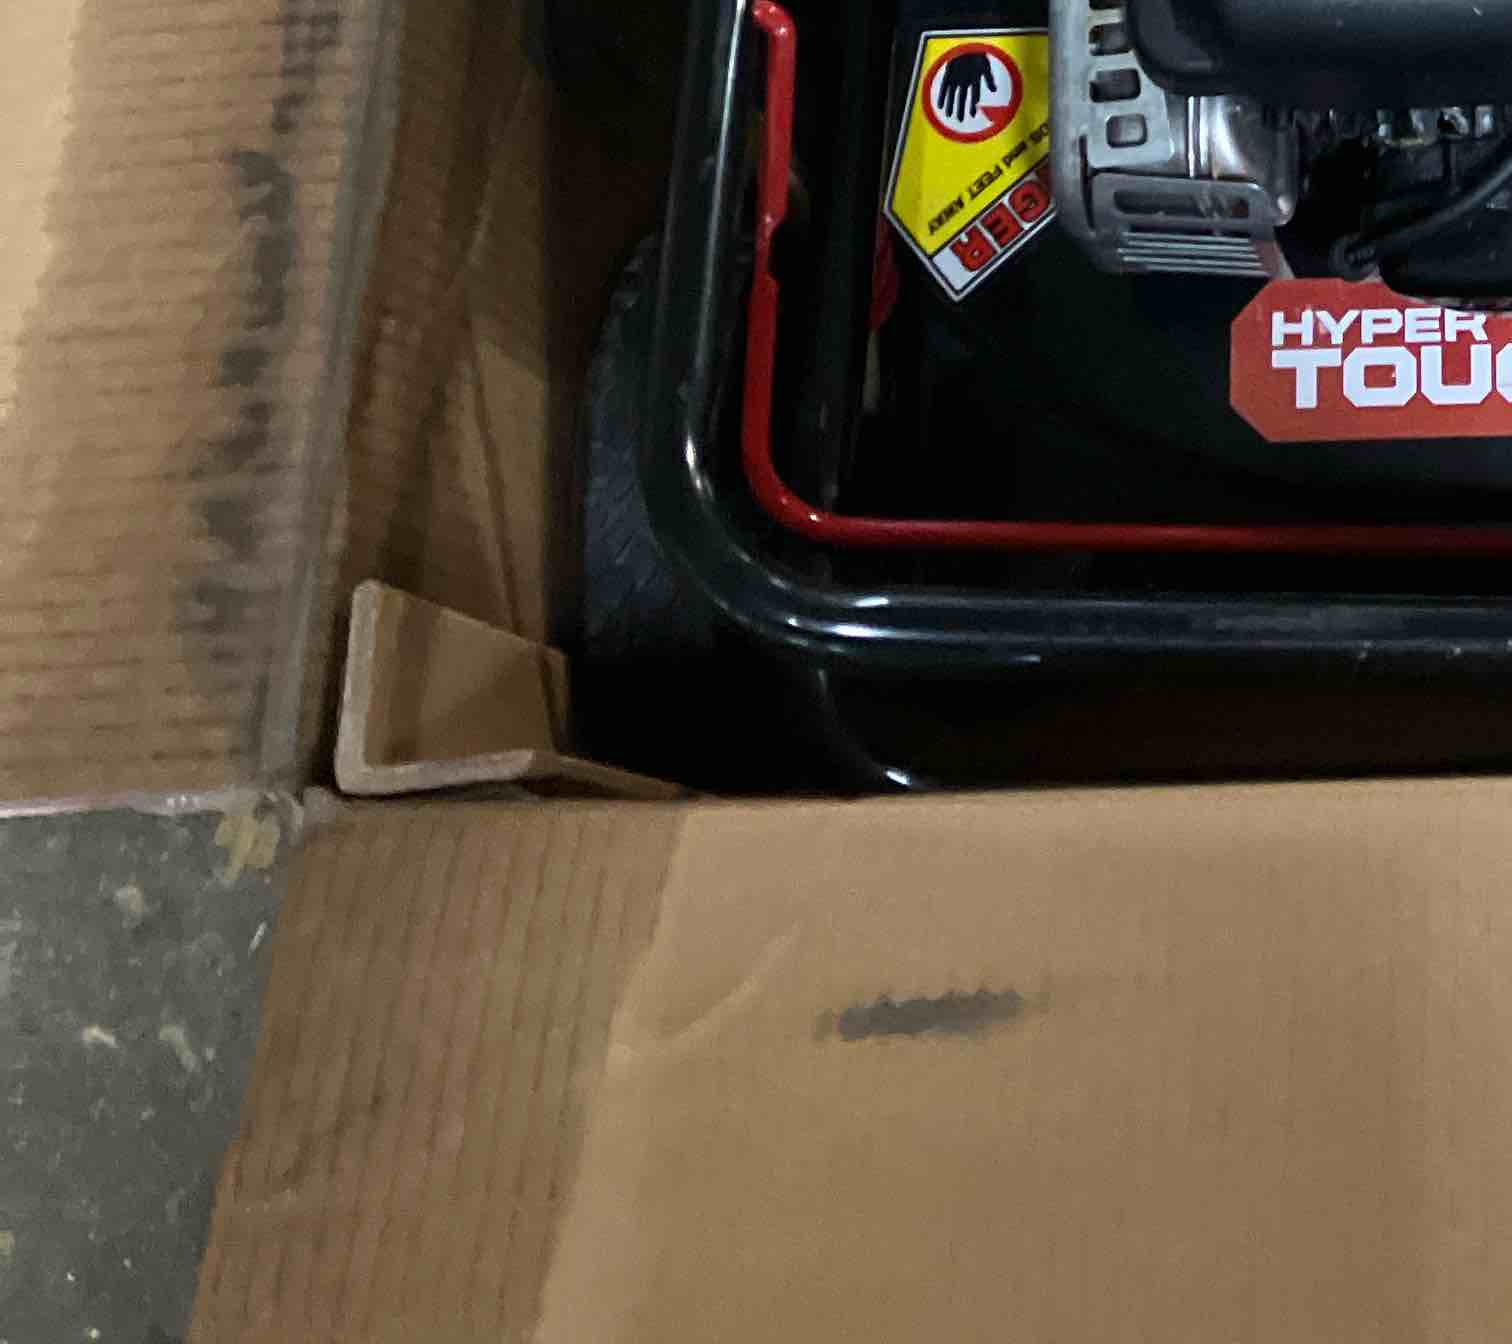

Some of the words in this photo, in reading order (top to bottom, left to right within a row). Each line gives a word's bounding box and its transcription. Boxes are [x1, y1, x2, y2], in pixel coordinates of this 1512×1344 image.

[969, 164, 1004, 201] FEET
[928, 195, 965, 236] AWAY
[1271, 308, 1488, 345] HYPER
